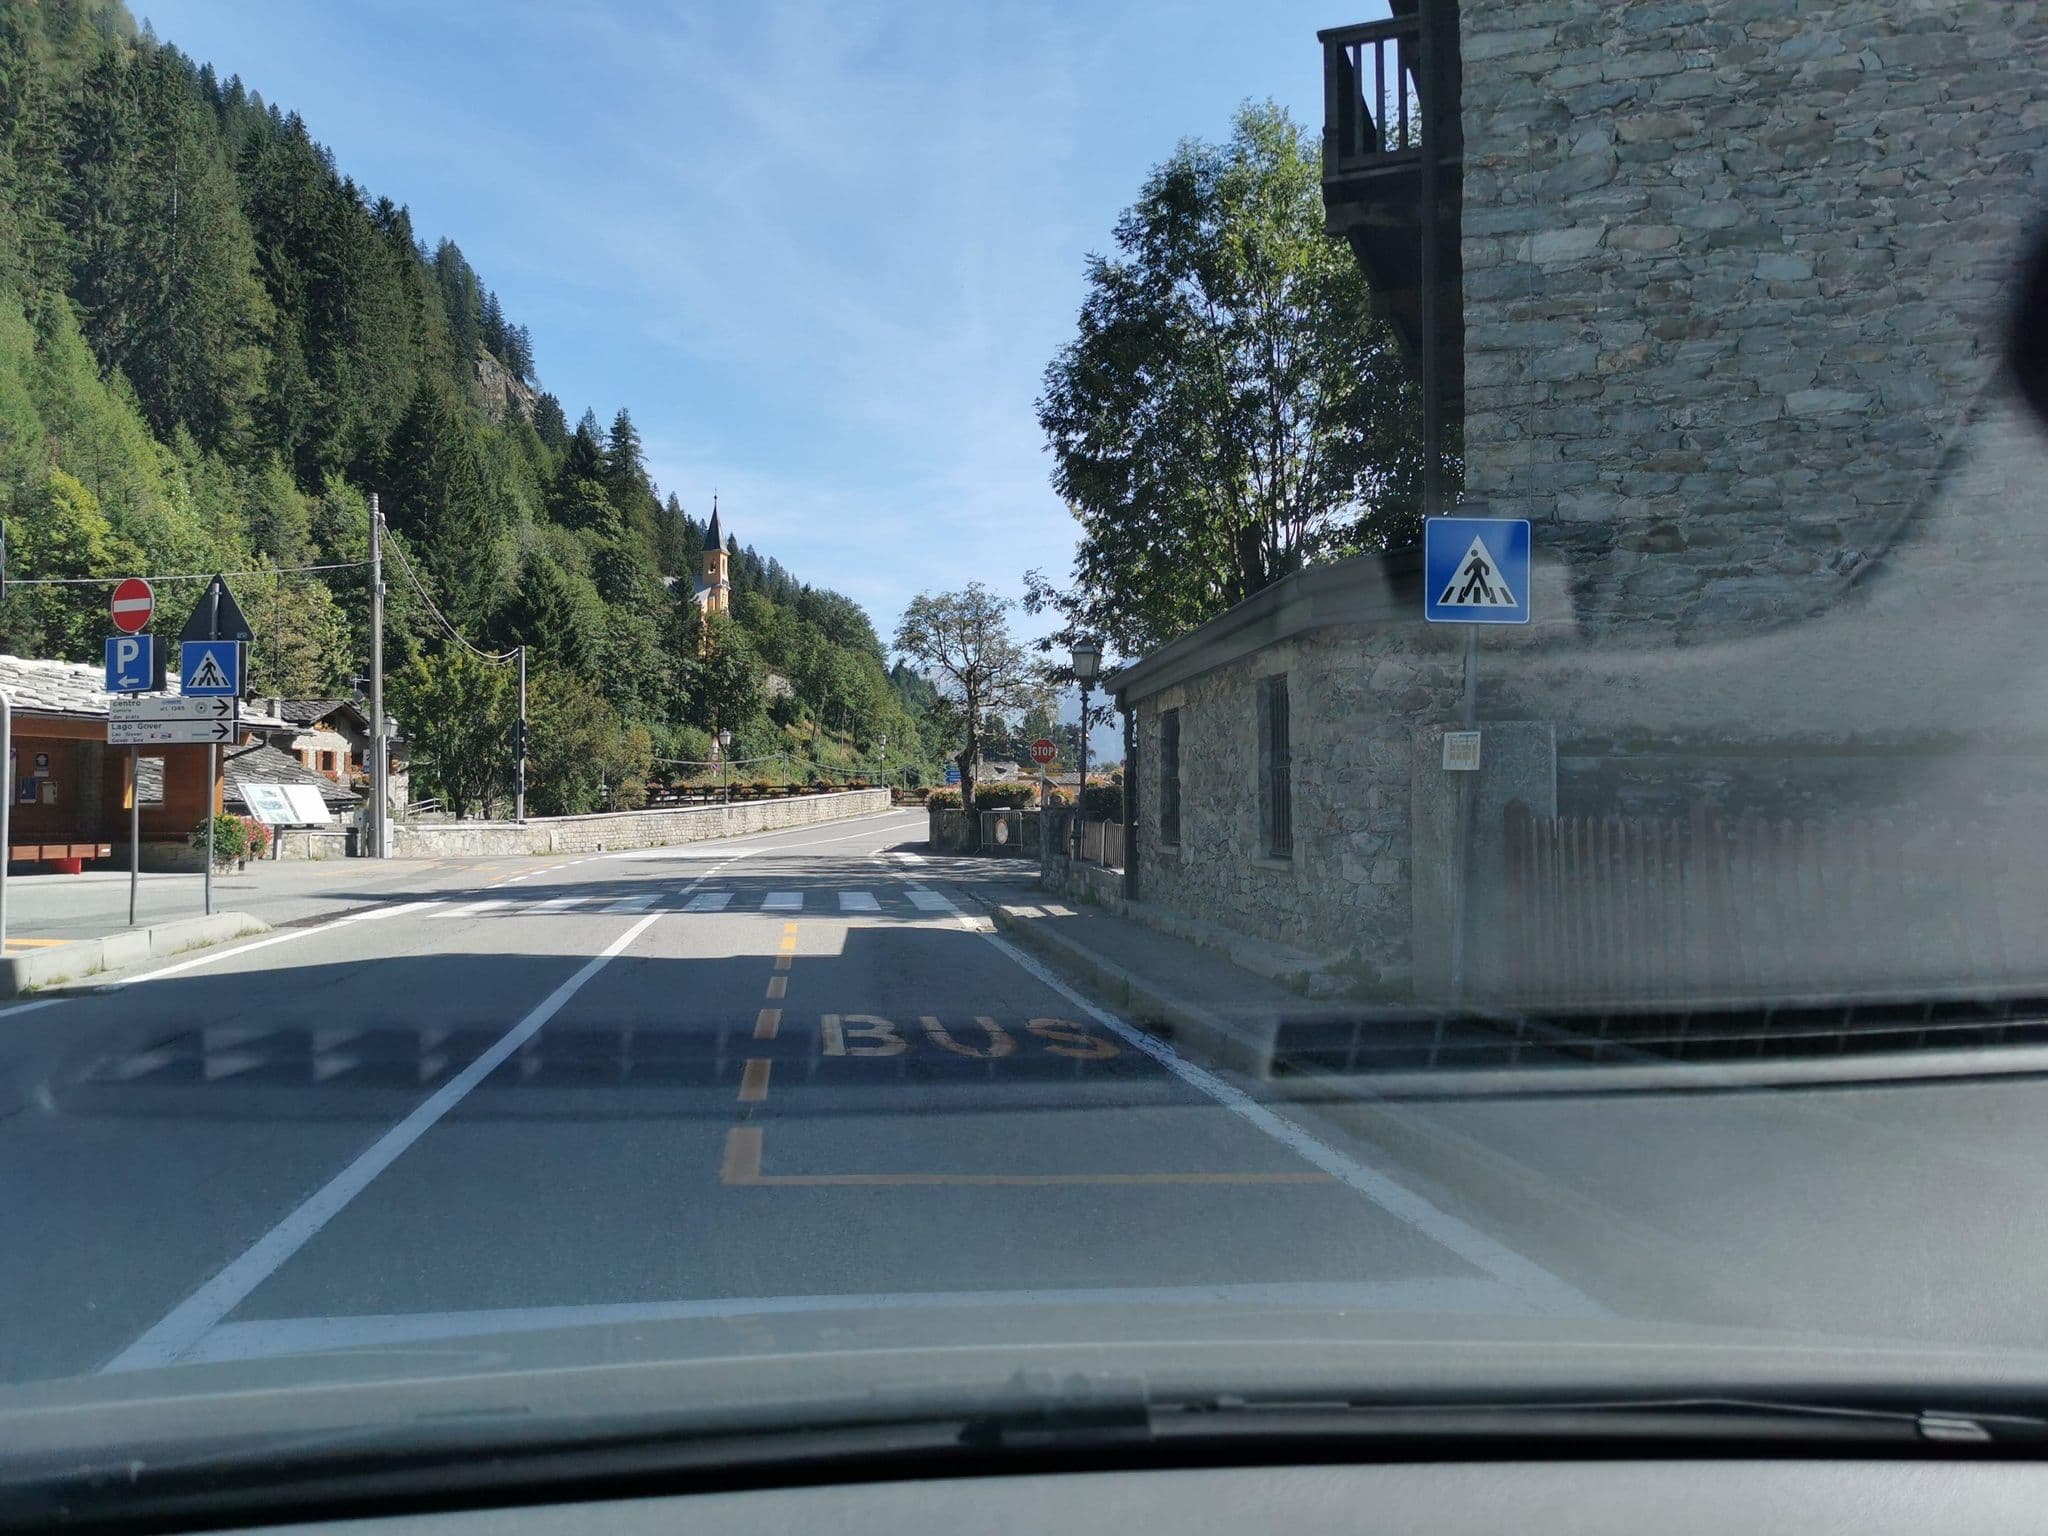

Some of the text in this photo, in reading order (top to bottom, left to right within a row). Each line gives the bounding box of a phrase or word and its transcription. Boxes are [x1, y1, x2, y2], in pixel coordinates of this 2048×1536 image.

[117, 638, 139, 674] P
[111, 722, 162, 731] Lago Gover
[1032, 746, 1053, 756] STOP
[820, 1013, 1121, 1060] BUS
